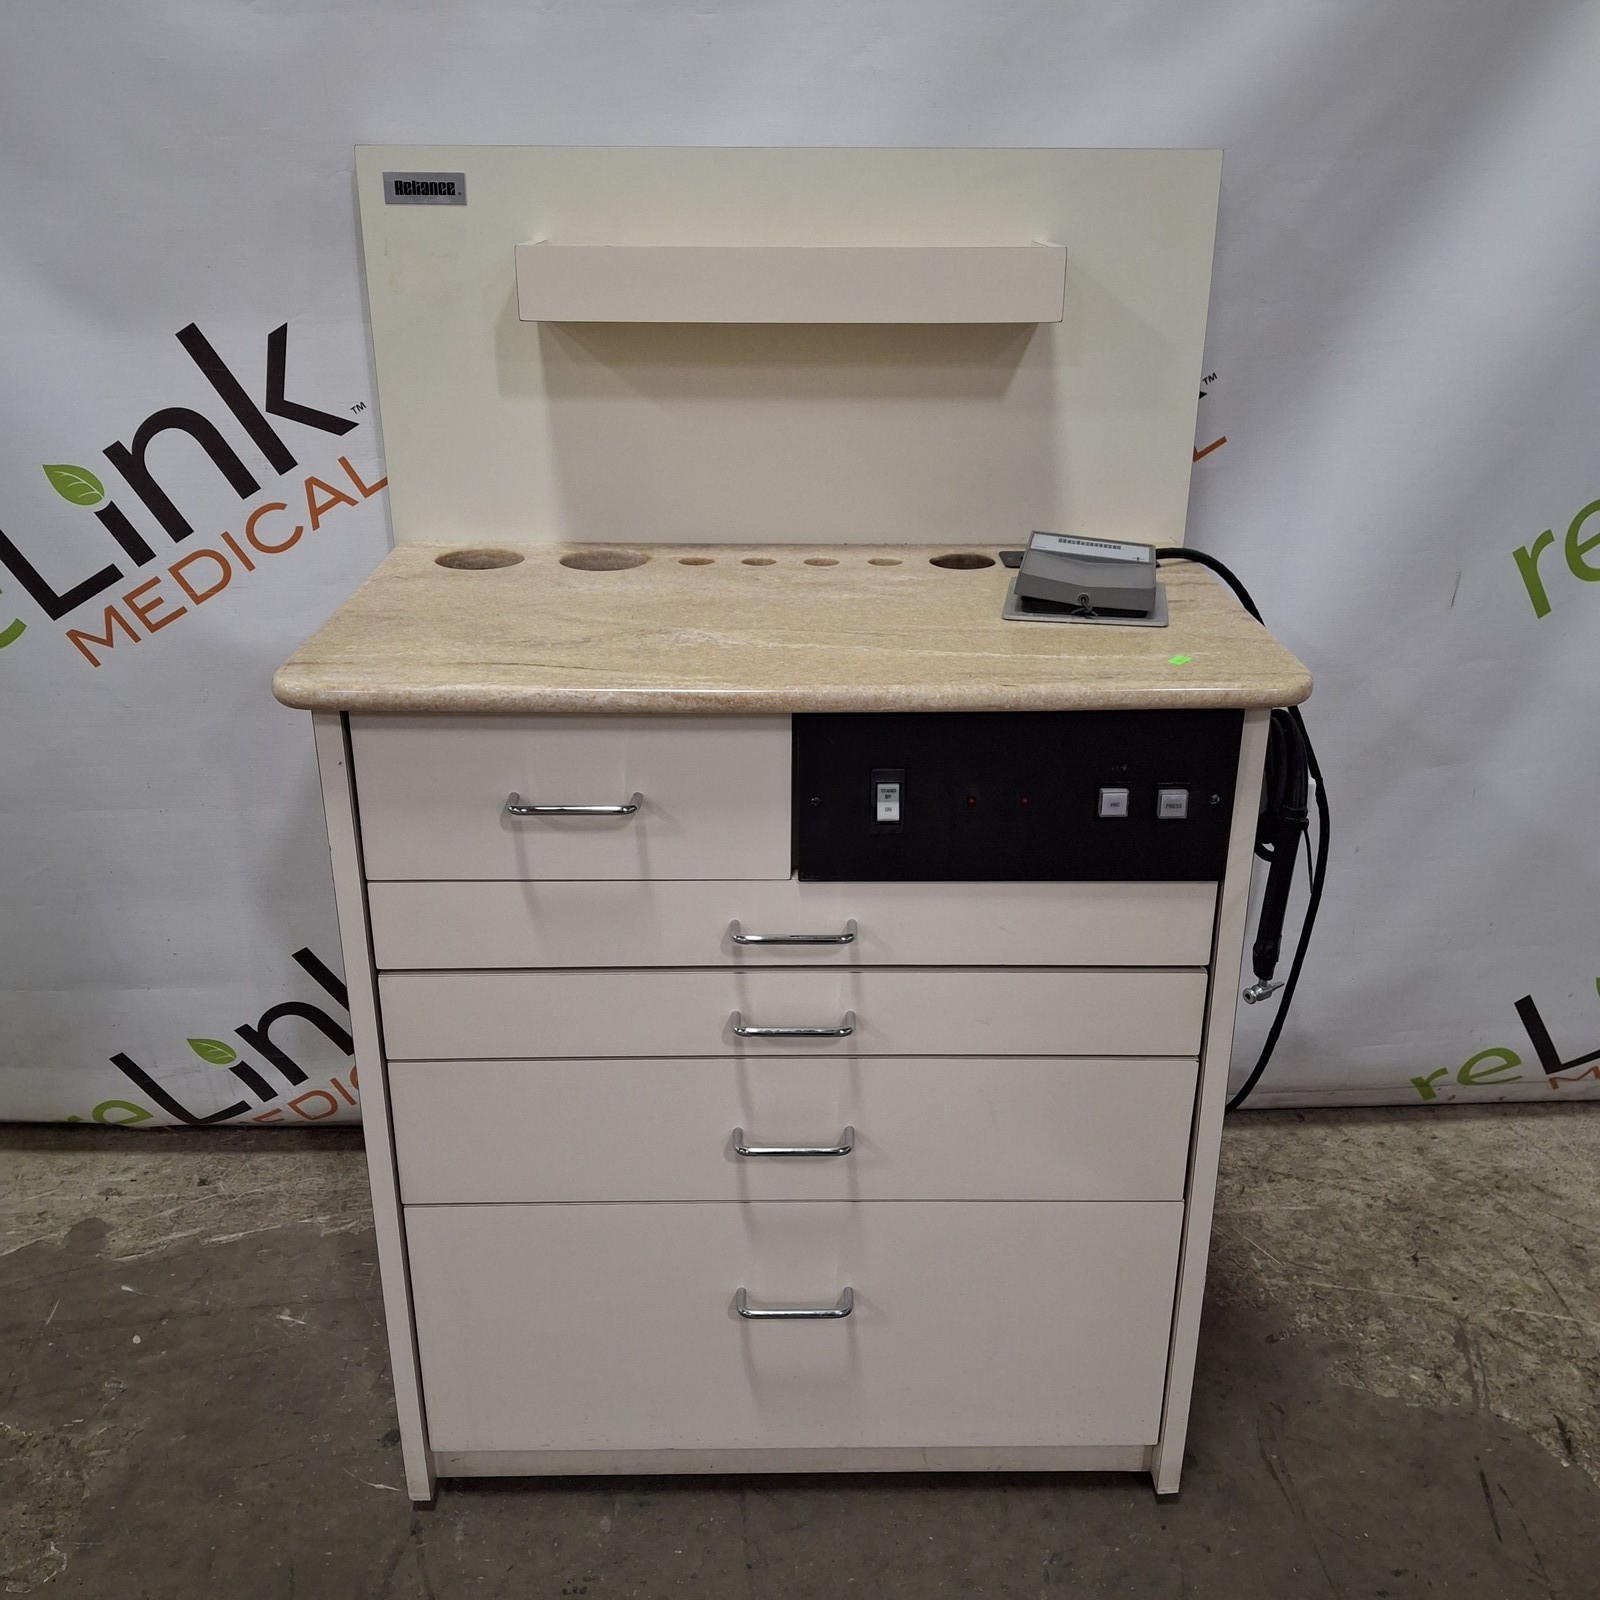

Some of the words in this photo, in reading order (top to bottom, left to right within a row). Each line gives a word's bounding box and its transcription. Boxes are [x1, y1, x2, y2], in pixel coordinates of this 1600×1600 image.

[394, 180, 456, 196] Reliance
[0, 322, 360, 648] Link
[65, 455, 388, 668] MEDICAL
